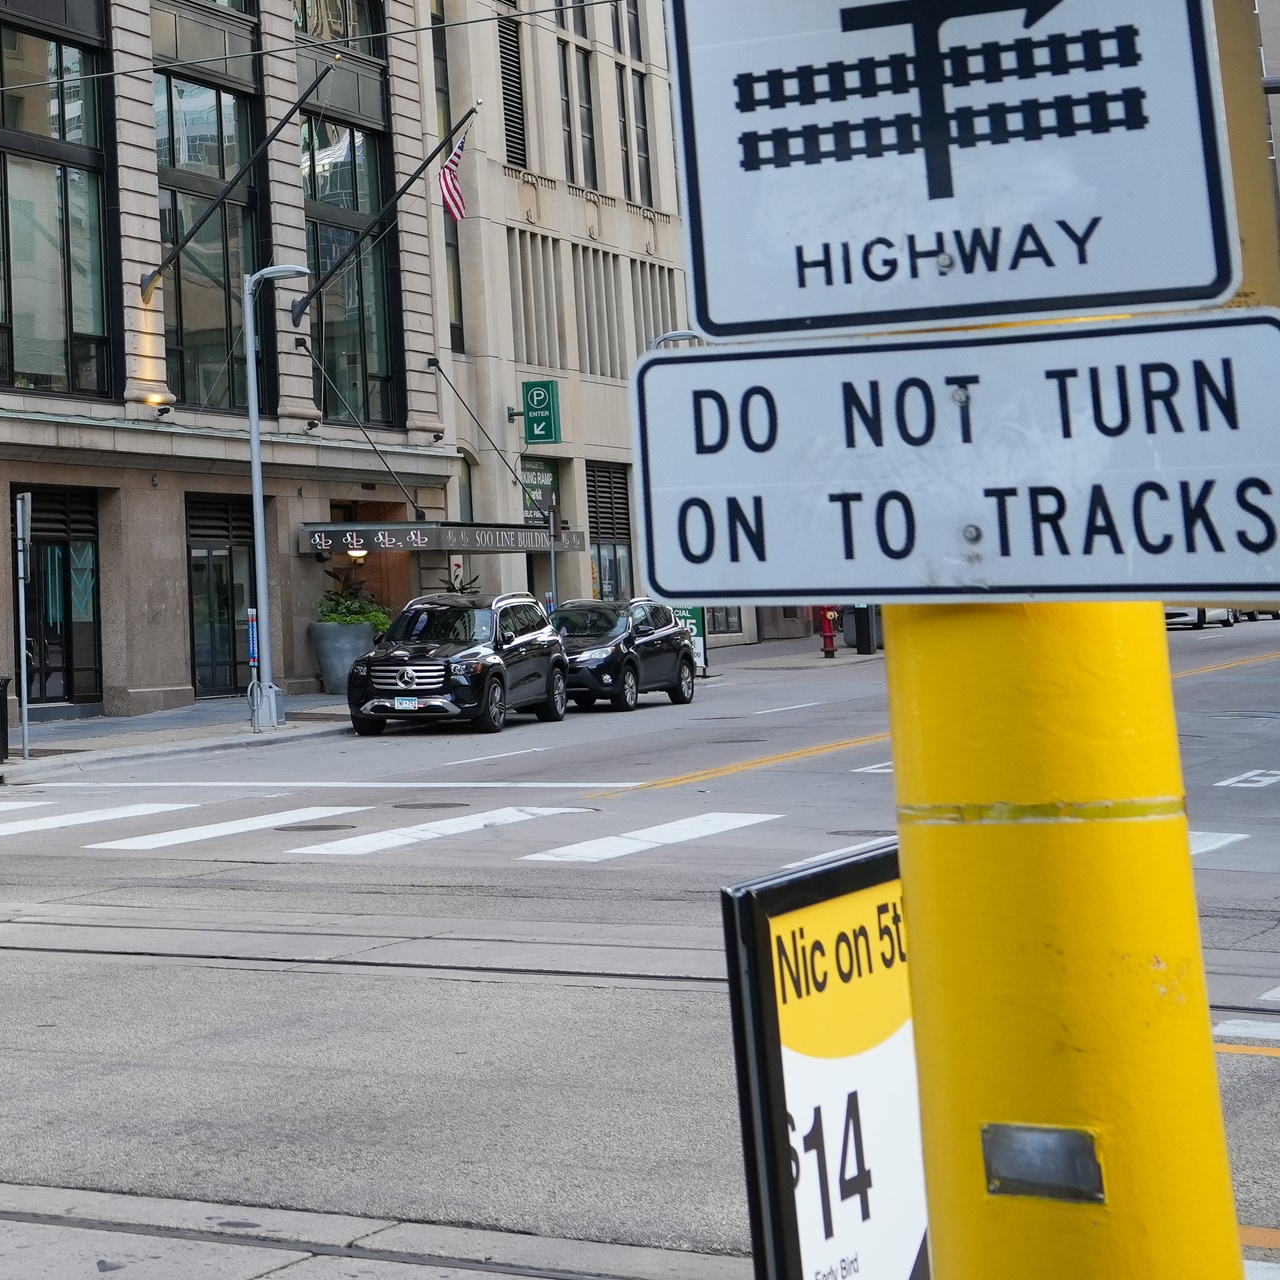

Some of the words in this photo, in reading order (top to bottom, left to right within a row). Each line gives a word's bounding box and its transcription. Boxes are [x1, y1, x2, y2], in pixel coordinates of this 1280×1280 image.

[795, 216, 1103, 290] HIGHWAY
[529, 410, 550, 418] ENTER
[692, 384, 778, 456] DO
[843, 374, 981, 450] NOT
[1045, 357, 1242, 440] TURN
[537, 472, 553, 486] RAMP
[679, 495, 768, 566] ON
[829, 488, 917, 561] TO
[983, 475, 1278, 560] TRACKS
[475, 530, 493, 547] SOO
[496, 531, 515, 547] LINE
[518, 532, 551, 549] BUILDIN
[674, 609, 691, 617] CIAL
[776, 926, 828, 1005] Nic
[835, 924, 874, 984] on
[876, 896, 908, 969] 5t
[840, 1251, 860, 1280] Bird
